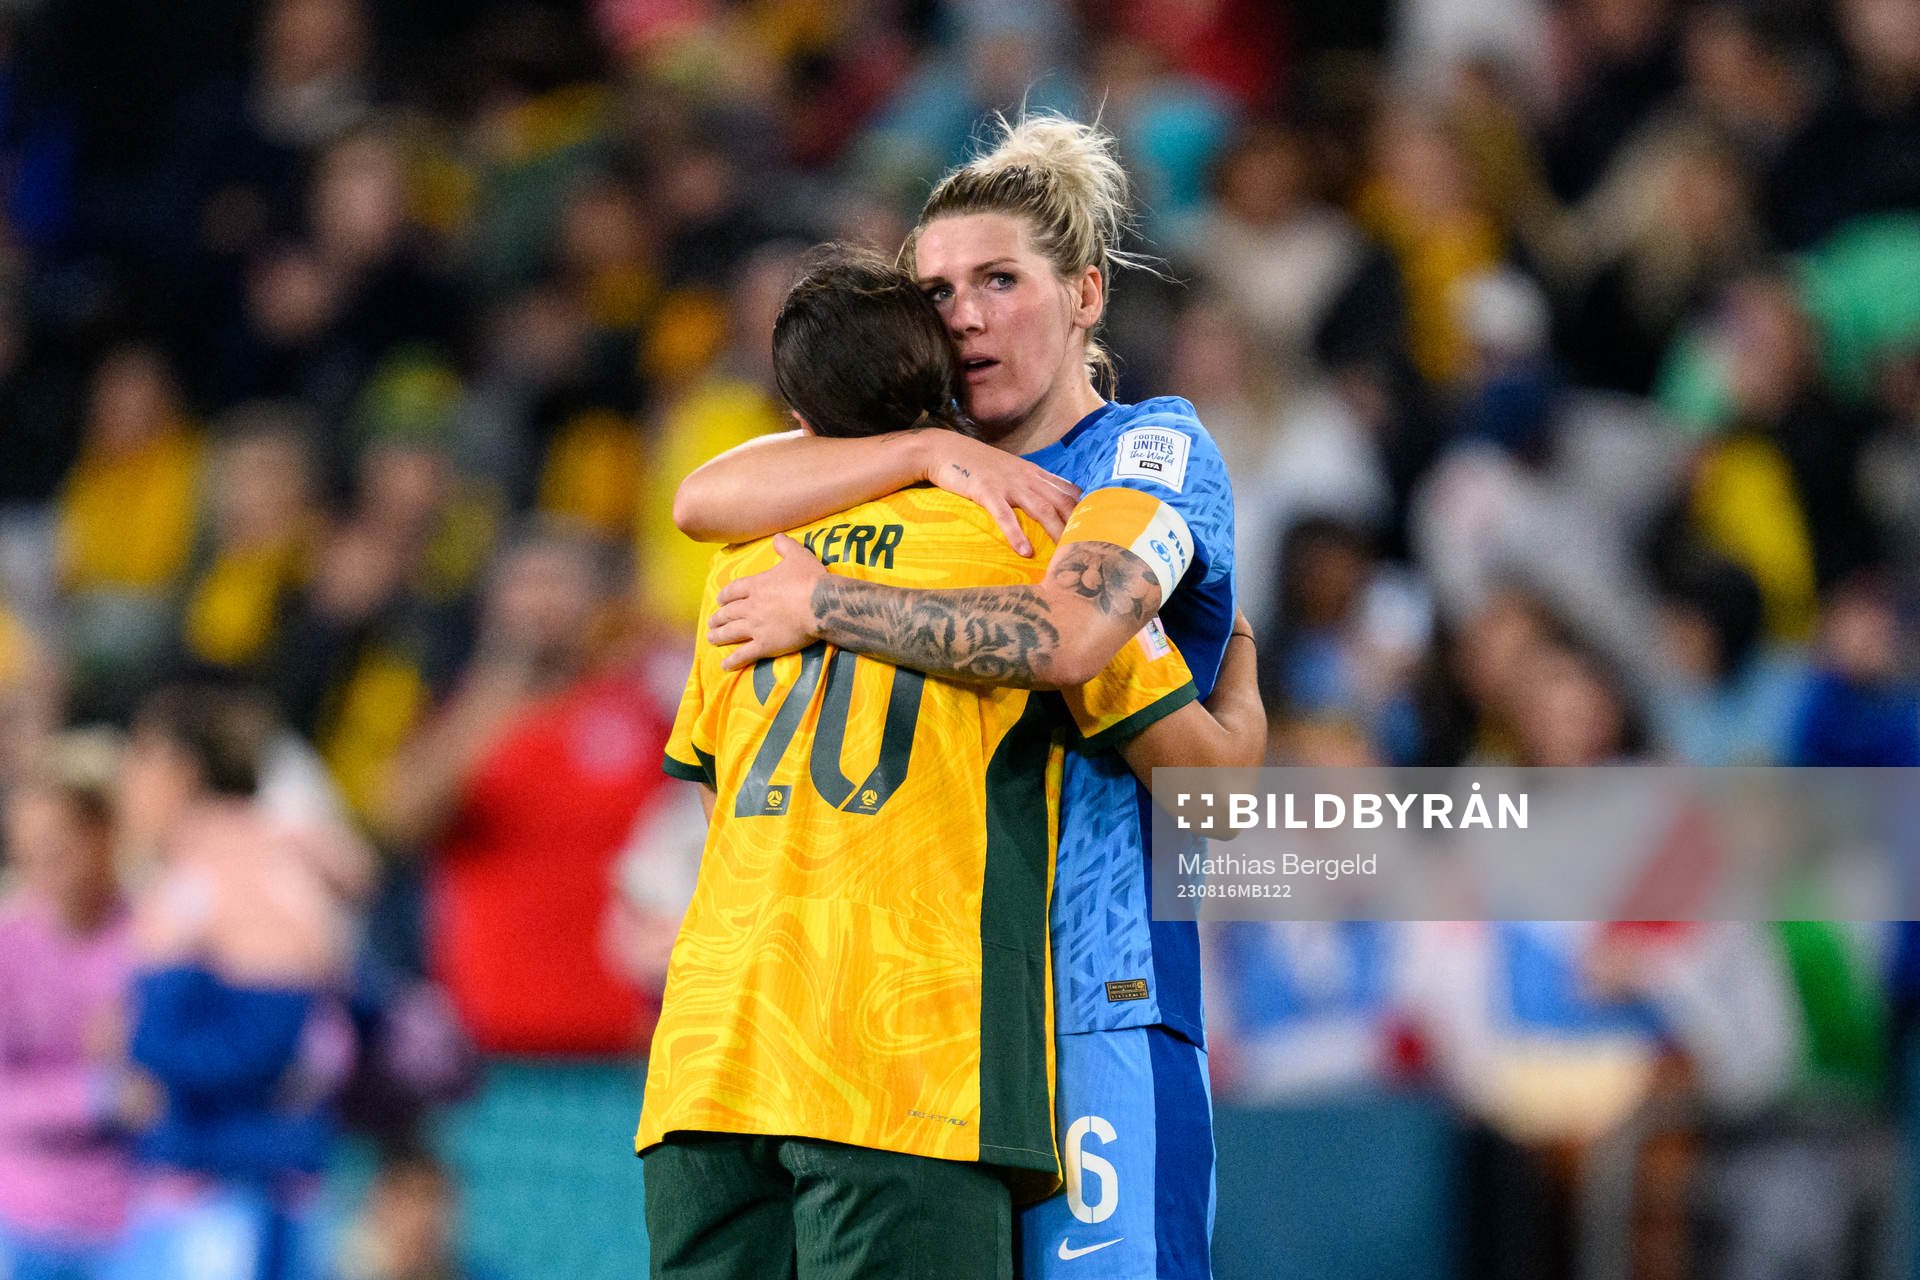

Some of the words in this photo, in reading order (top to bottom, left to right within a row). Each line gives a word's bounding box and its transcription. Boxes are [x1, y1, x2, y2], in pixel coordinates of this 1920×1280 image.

[1133, 434, 1173, 444] FOOTBALL
[1133, 440, 1173, 455] UNITES
[1140, 461, 1162, 471] FIFA
[734, 639, 927, 818] 20
[1065, 1115, 1119, 1224] 6
